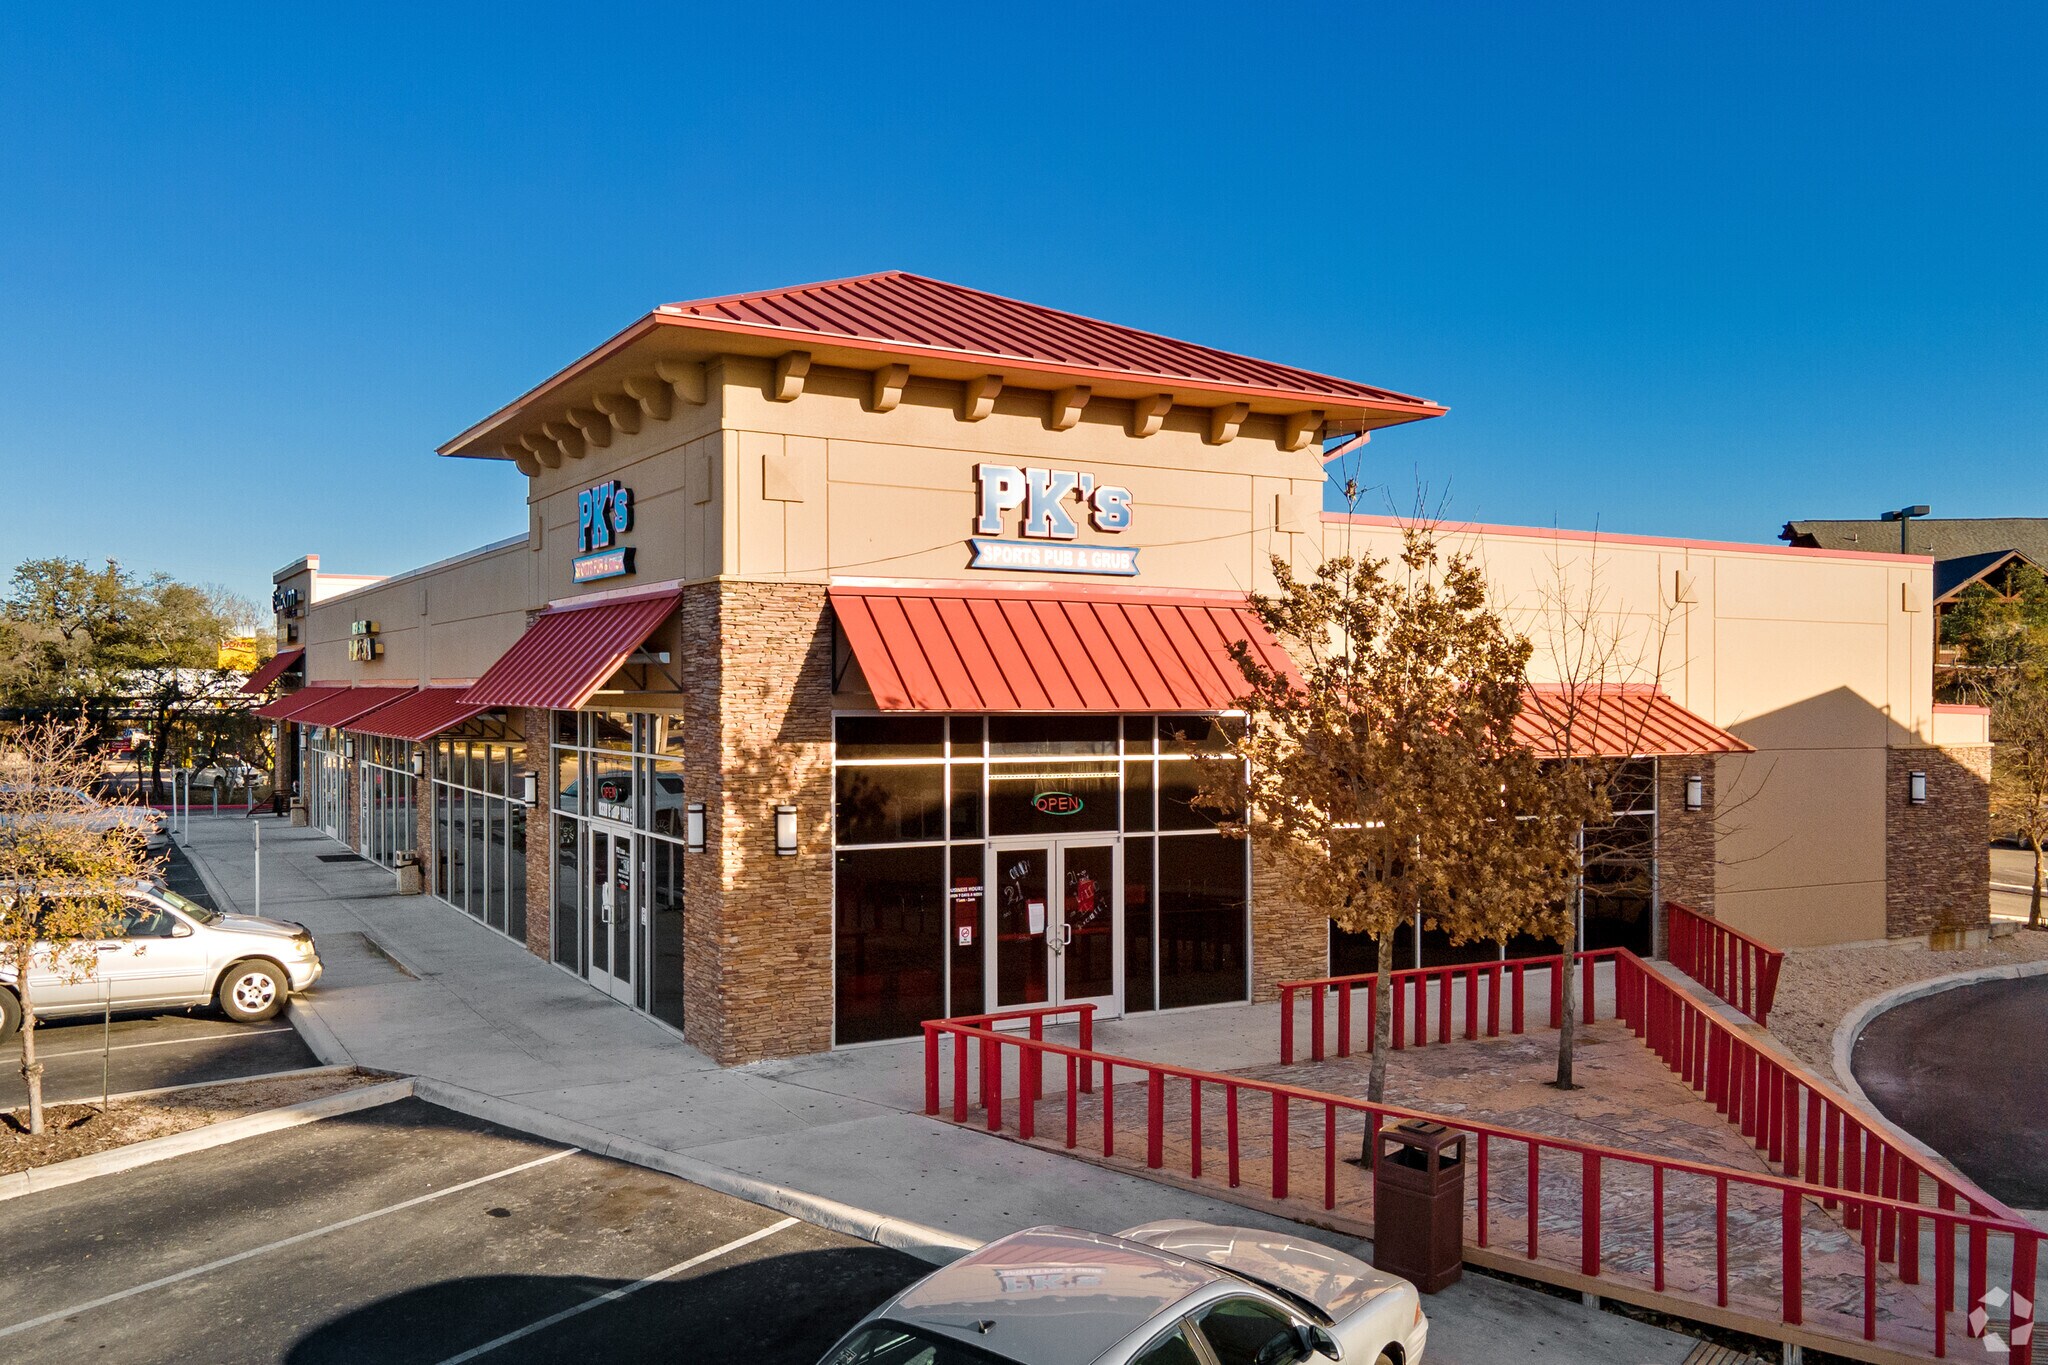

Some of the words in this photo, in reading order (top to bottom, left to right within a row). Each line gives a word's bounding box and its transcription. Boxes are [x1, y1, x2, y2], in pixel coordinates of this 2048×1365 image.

[578, 480, 632, 553] PK's
[973, 463, 1134, 540] PK's
[983, 545, 1041, 567] SPORTS
[1045, 549, 1073, 567] PUB
[1077, 551, 1088, 567] &
[1092, 552, 1131, 570] GRUB
[1036, 796, 1080, 812] OPEN
